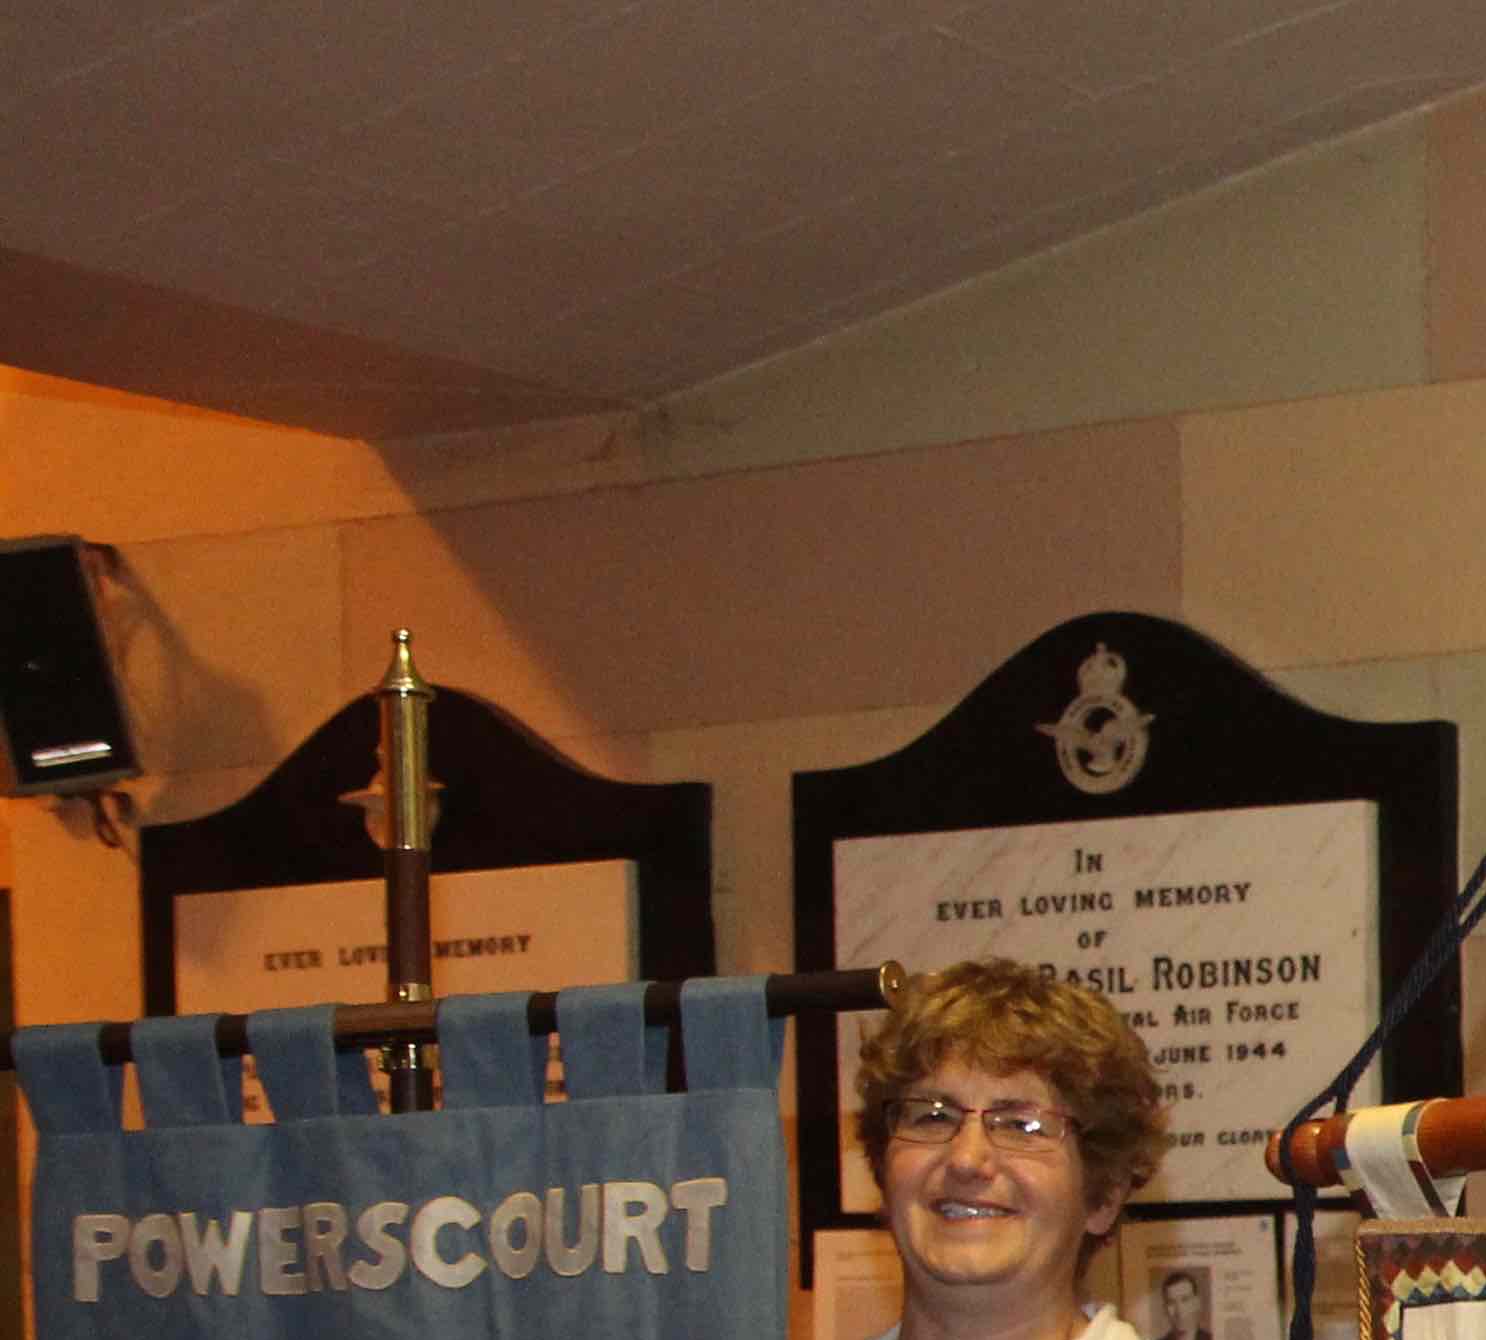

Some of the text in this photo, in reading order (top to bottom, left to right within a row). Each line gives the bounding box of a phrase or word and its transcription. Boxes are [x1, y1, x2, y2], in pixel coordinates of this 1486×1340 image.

[1074, 849, 1104, 873] IN
[936, 881, 1252, 921] EVER LOVING MEMORY
[264, 949, 322, 971] EVER
[432, 935, 532, 959] MEMORY
[1077, 930, 1107, 950] OF
[1153, 953, 1322, 991] ROBINSON
[1173, 1003, 1212, 1027] AIR
[1225, 1000, 1301, 1024] FORCE
[1153, 1042, 1288, 1066] JUNE 1944
[73, 1178, 728, 1302] POWERSCOURT
